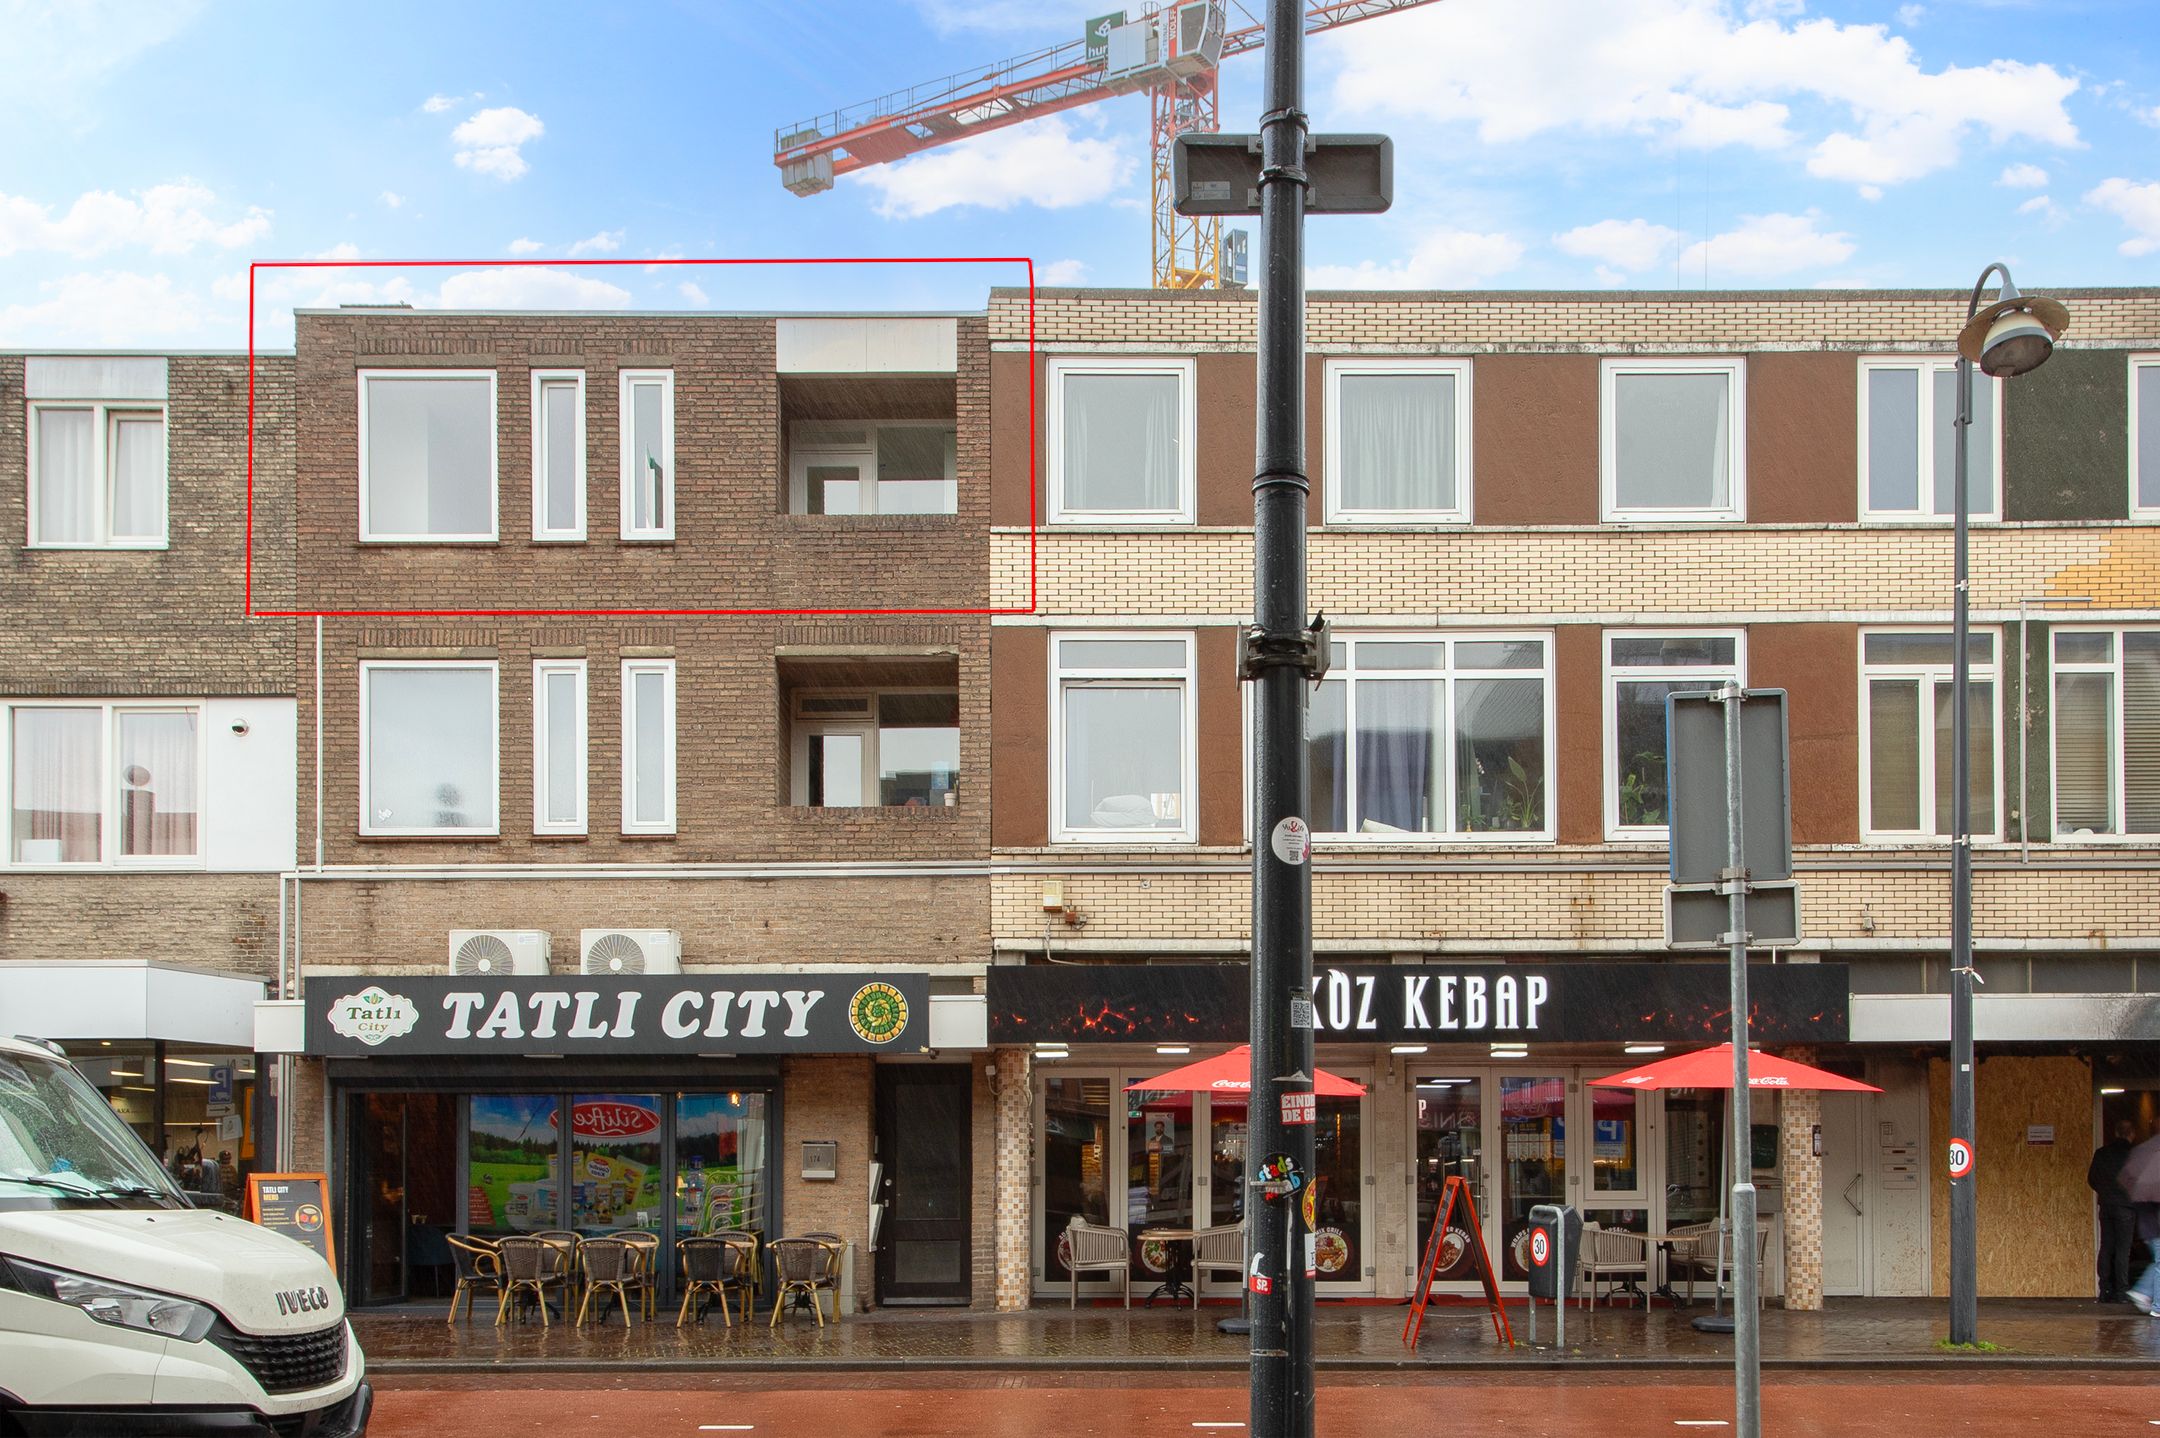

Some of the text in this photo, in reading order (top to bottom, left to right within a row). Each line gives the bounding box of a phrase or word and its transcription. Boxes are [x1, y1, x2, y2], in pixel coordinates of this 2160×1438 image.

[1168, 8, 1177, 40] WOLFF
[1088, 45, 1108, 58] hur
[1403, 975, 1548, 1030] KEBAP
[442, 990, 825, 1039] TATLI CITY
[358, 1022, 389, 1032] City
[1282, 1109, 1301, 1122] DE
[1326, 1227, 1343, 1236] GRILL
[1510, 1229, 1527, 1248] WRAPS
[1534, 1239, 1545, 1255] 30
[275, 1286, 329, 1316] IVECO
